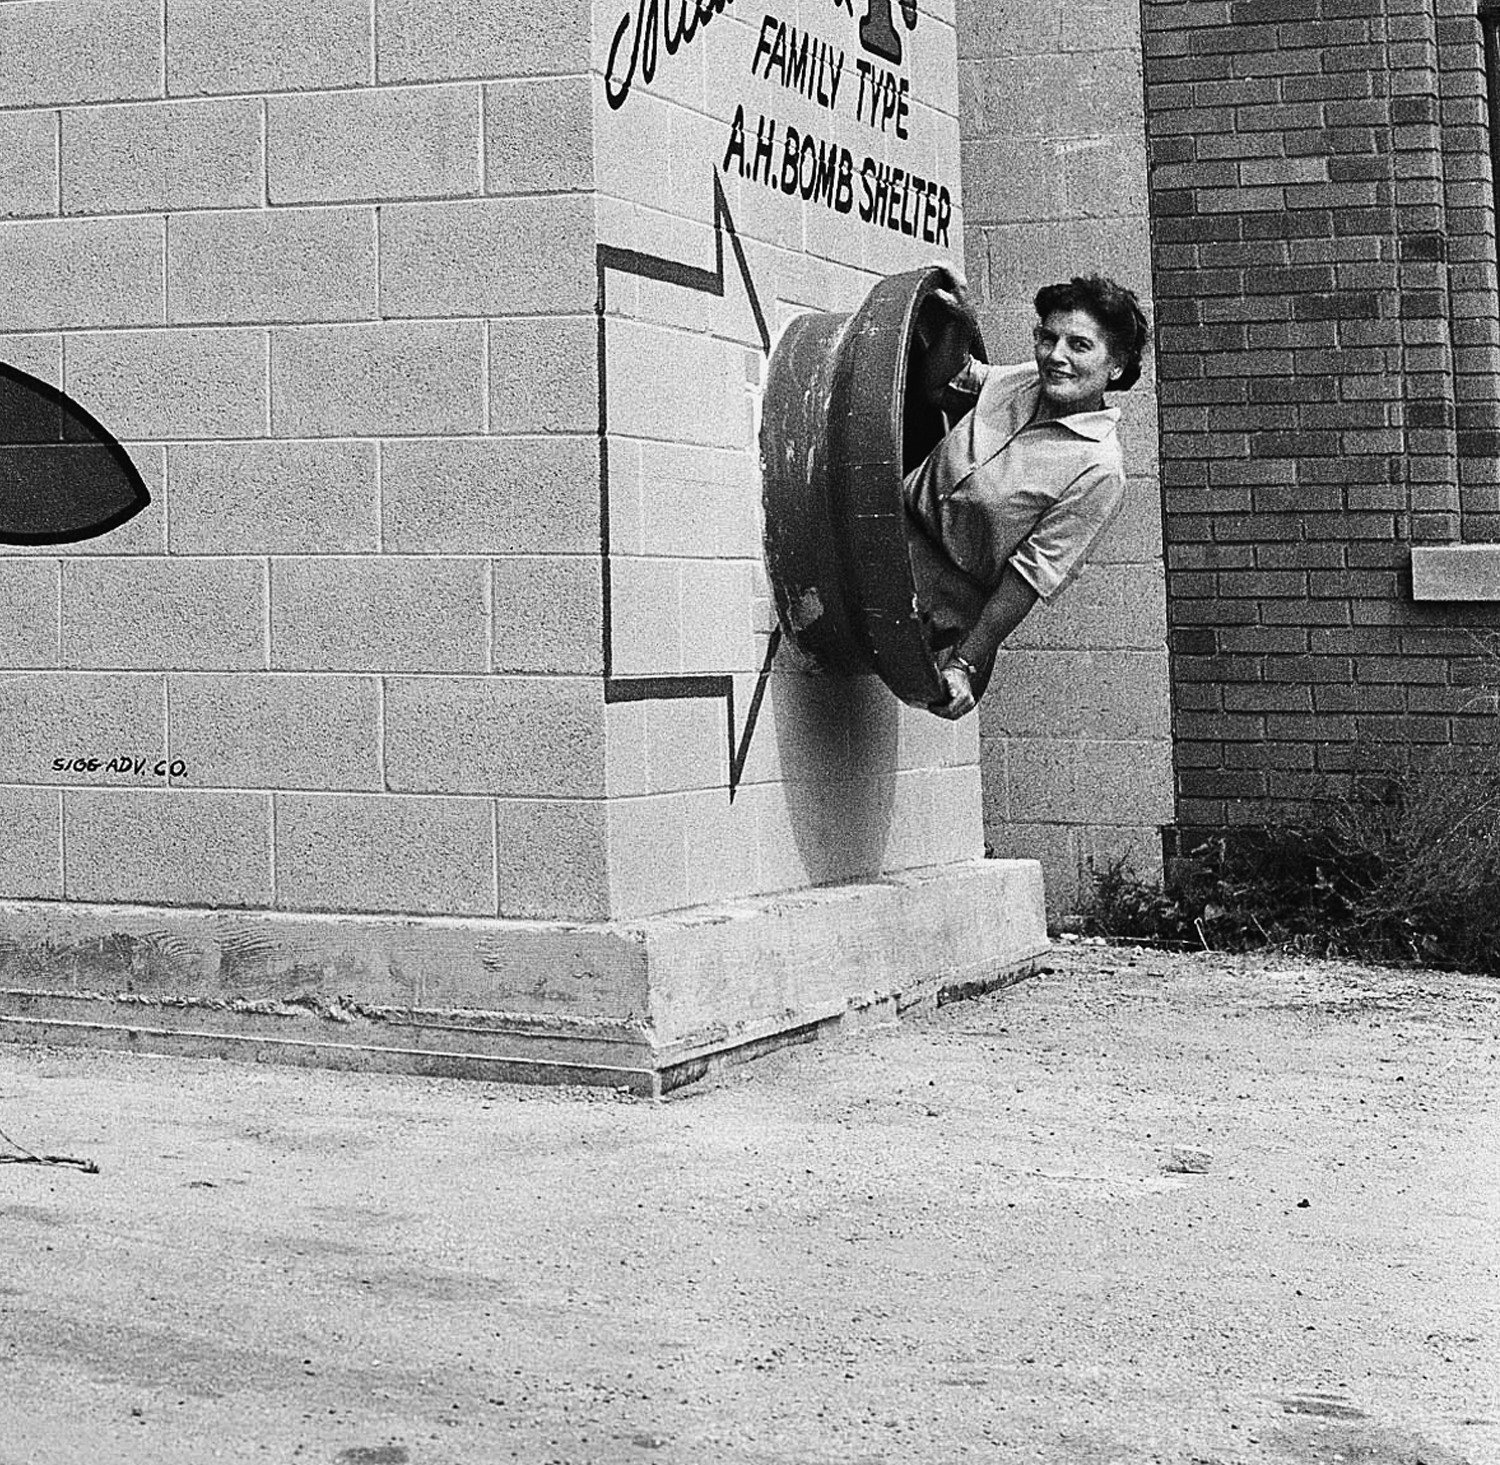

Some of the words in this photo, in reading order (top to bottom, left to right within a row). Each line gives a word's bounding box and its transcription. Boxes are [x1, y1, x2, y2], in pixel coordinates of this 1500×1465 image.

[752, 15, 844, 110] FAMILY
[856, 58, 909, 140] TYPE
[858, 157, 952, 248] SHELTER
[105, 756, 146, 776] ADV.
[154, 760, 188, 778] CO.
